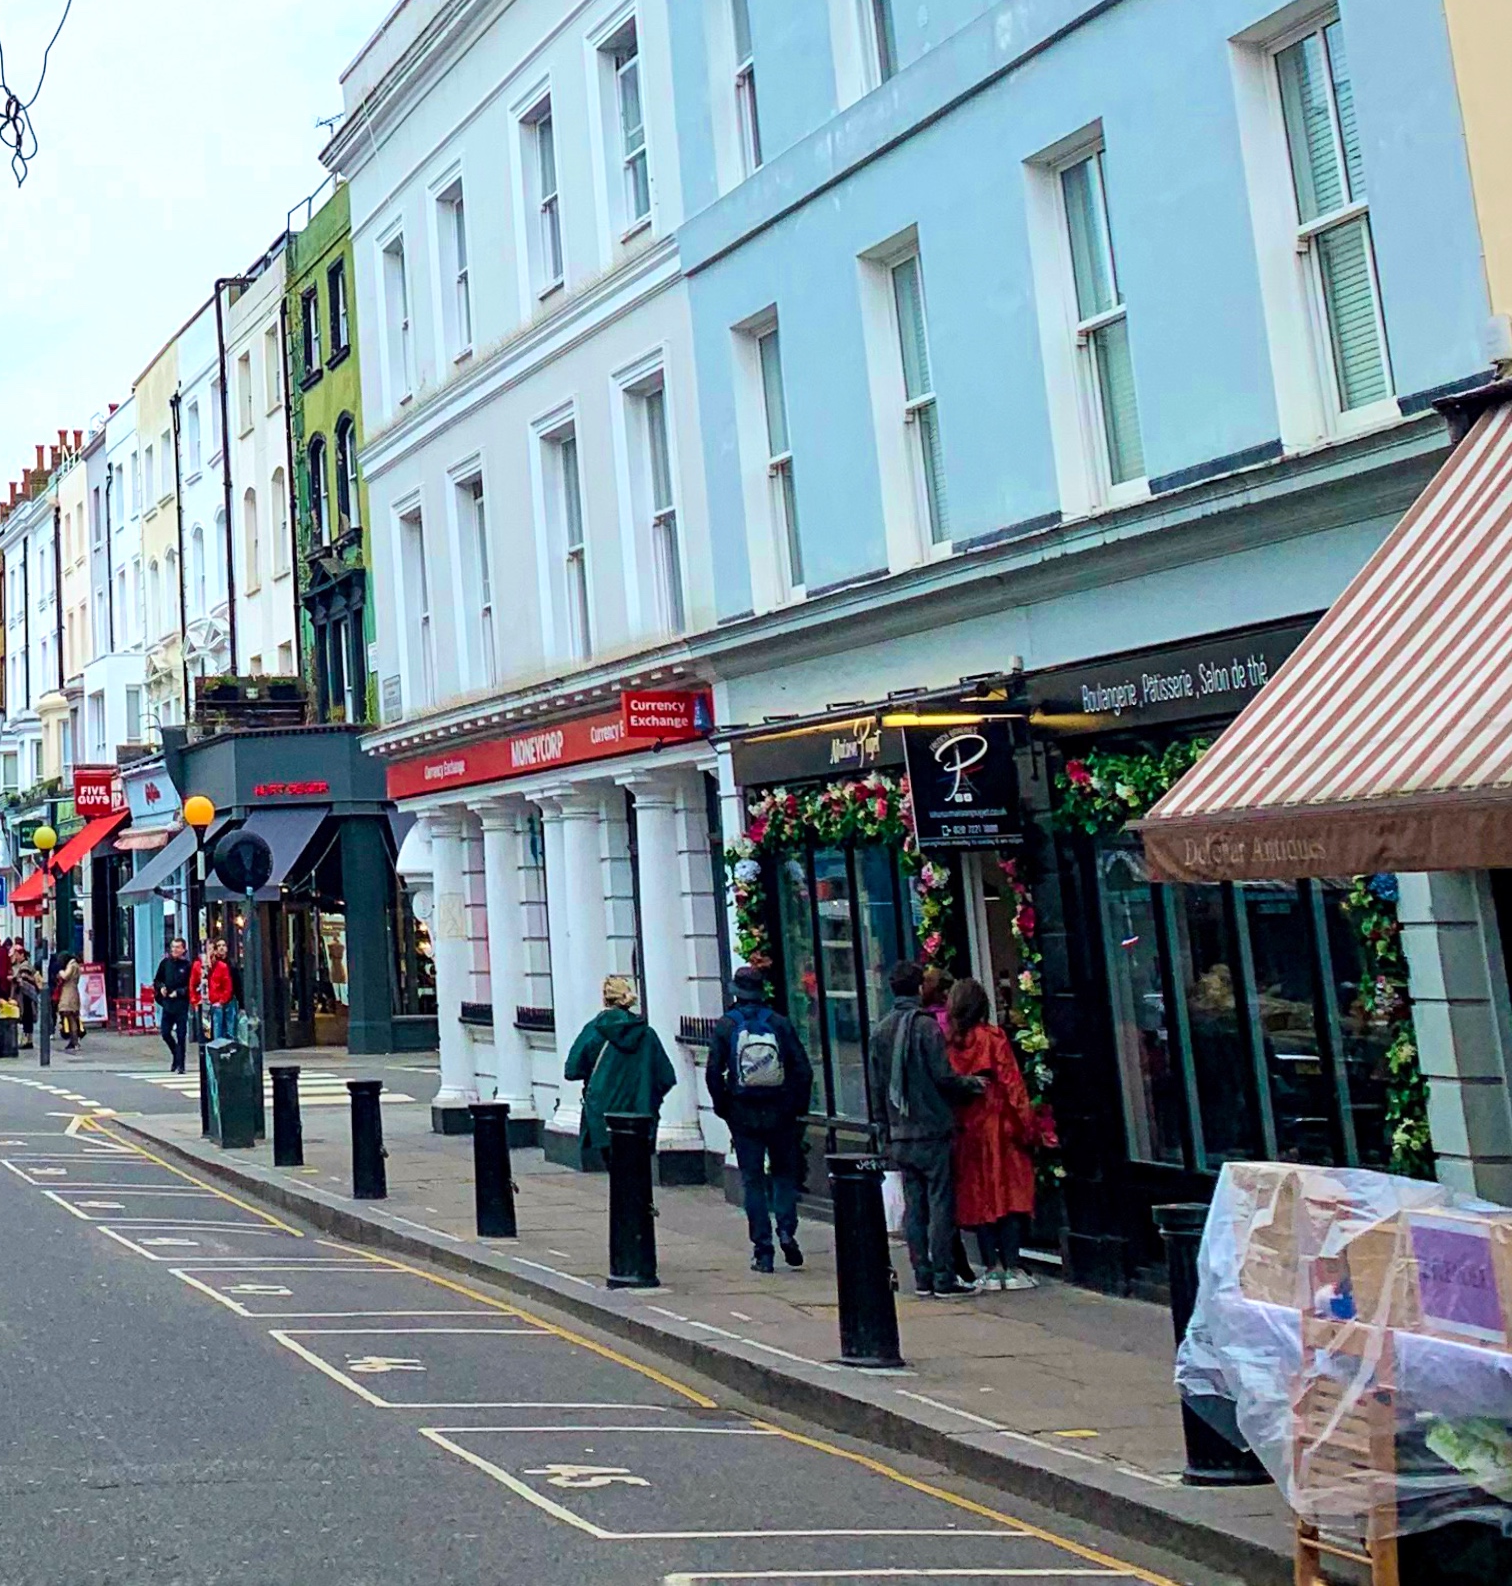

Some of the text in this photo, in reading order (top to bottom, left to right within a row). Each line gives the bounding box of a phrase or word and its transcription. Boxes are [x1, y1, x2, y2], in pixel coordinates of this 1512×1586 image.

[1198, 662, 1229, 695] Salon
[1231, 658, 1246, 688] de
[1247, 653, 1268, 686] thé
[630, 699, 685, 713] Currency
[630, 714, 689, 729] Exchange
[590, 722, 620, 744] Currency
[511, 729, 564, 767] MONEYCORP
[80, 785, 107, 796] FIVE
[77, 795, 110, 806] GUYS
[1250, 836, 1326, 863] Antiques
